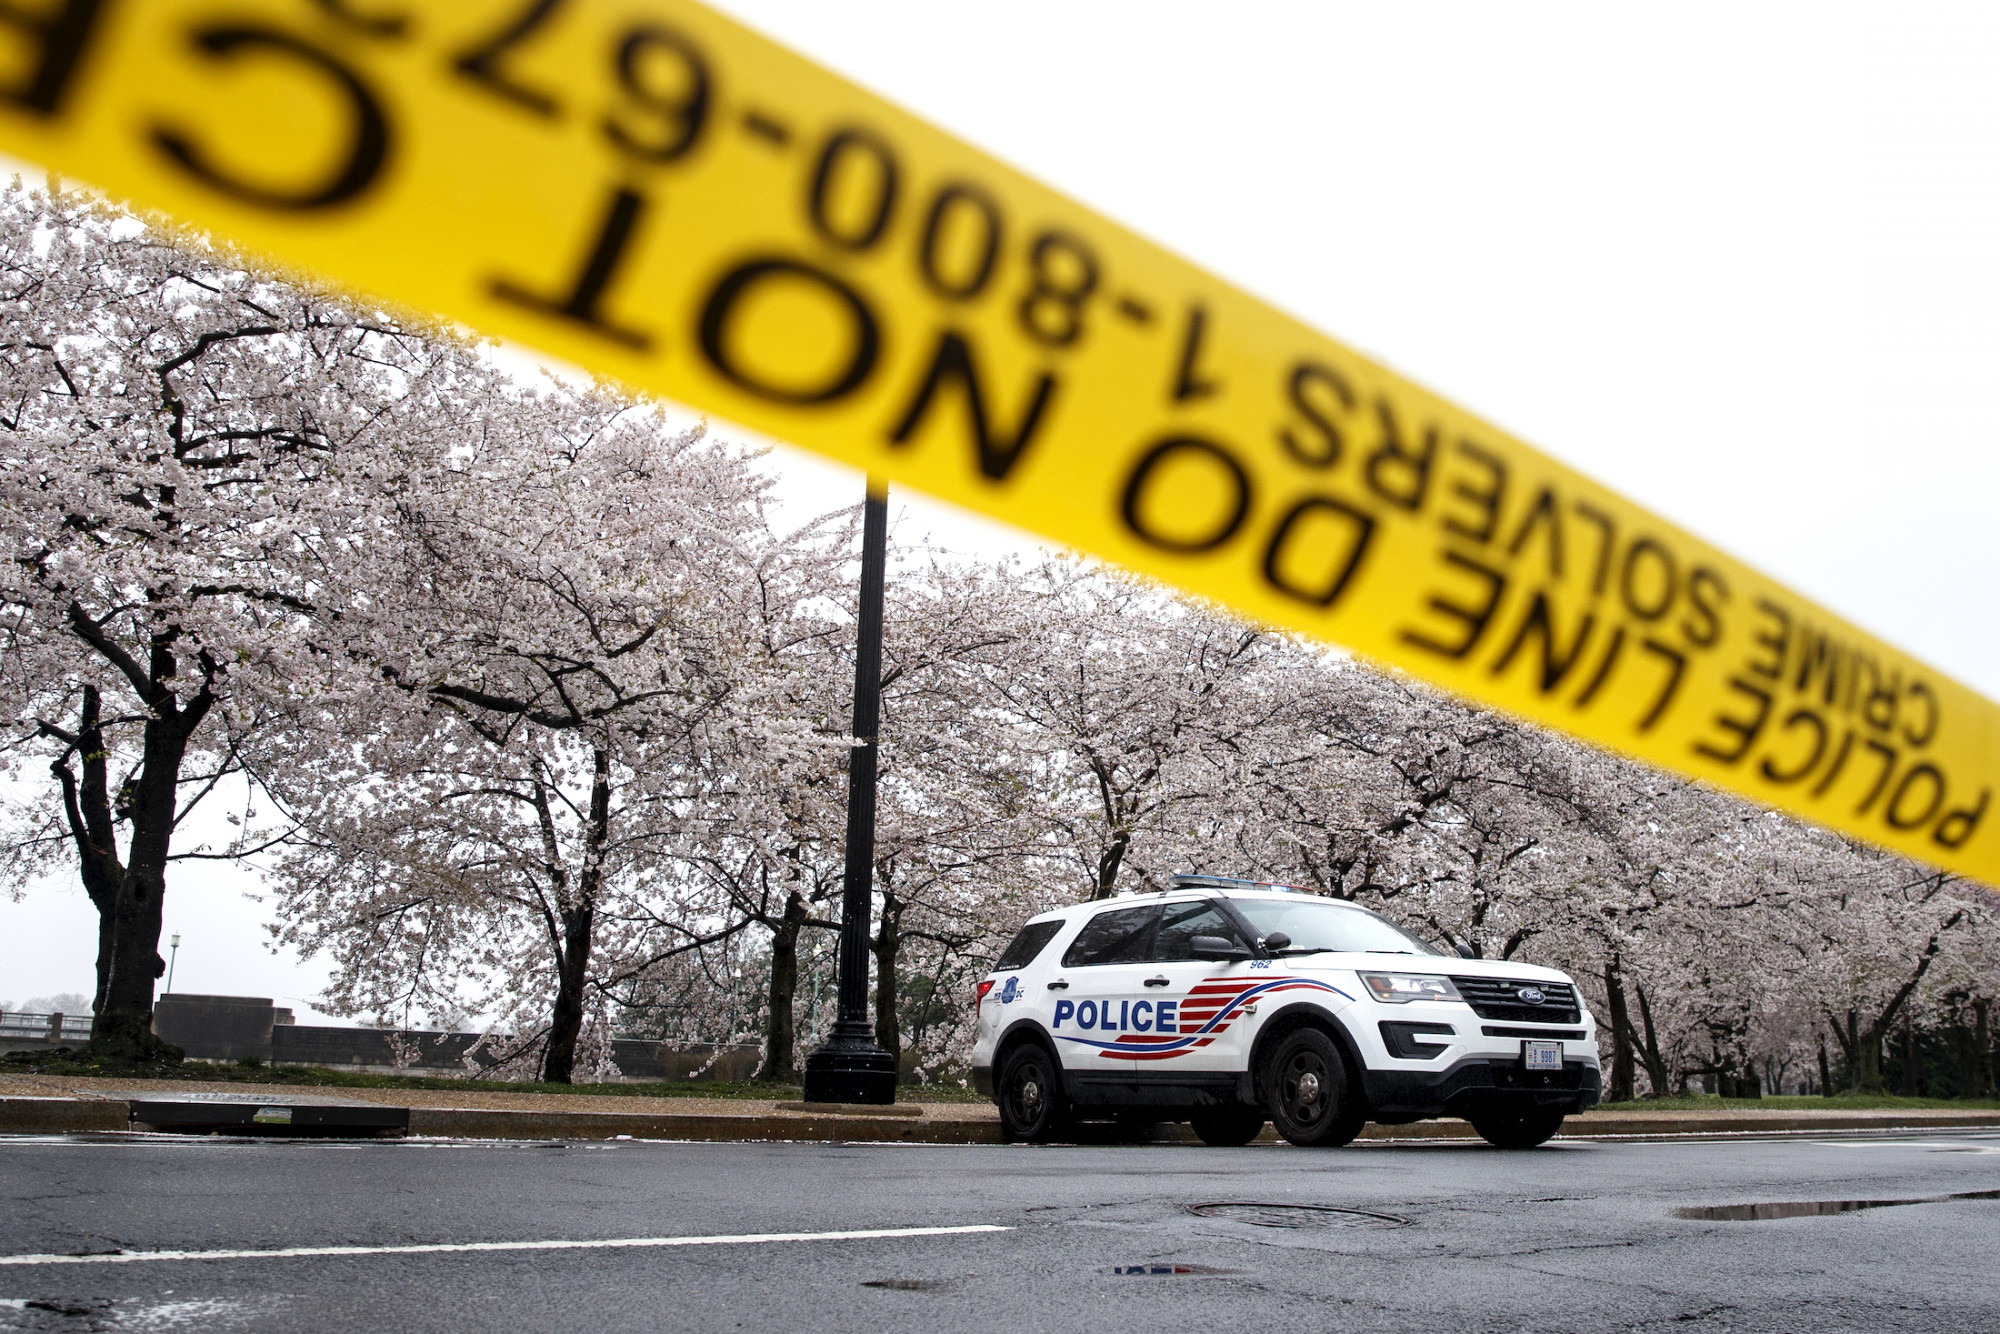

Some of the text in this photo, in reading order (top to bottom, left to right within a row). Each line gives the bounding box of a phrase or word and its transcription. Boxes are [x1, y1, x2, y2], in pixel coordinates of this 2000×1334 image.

[312, 0, 1940, 748] CRIME SOLVERS 1-800-67
[482, 186, 1061, 485] NOT
[1118, 434, 1377, 606] DO
[1397, 548, 1688, 733] LINE
[1691, 677, 1992, 849] POLICE
[1053, 1000, 1177, 1032] POLICE
[1250, 960, 1272, 969] 962
[1541, 1050, 1556, 1063] 9987
